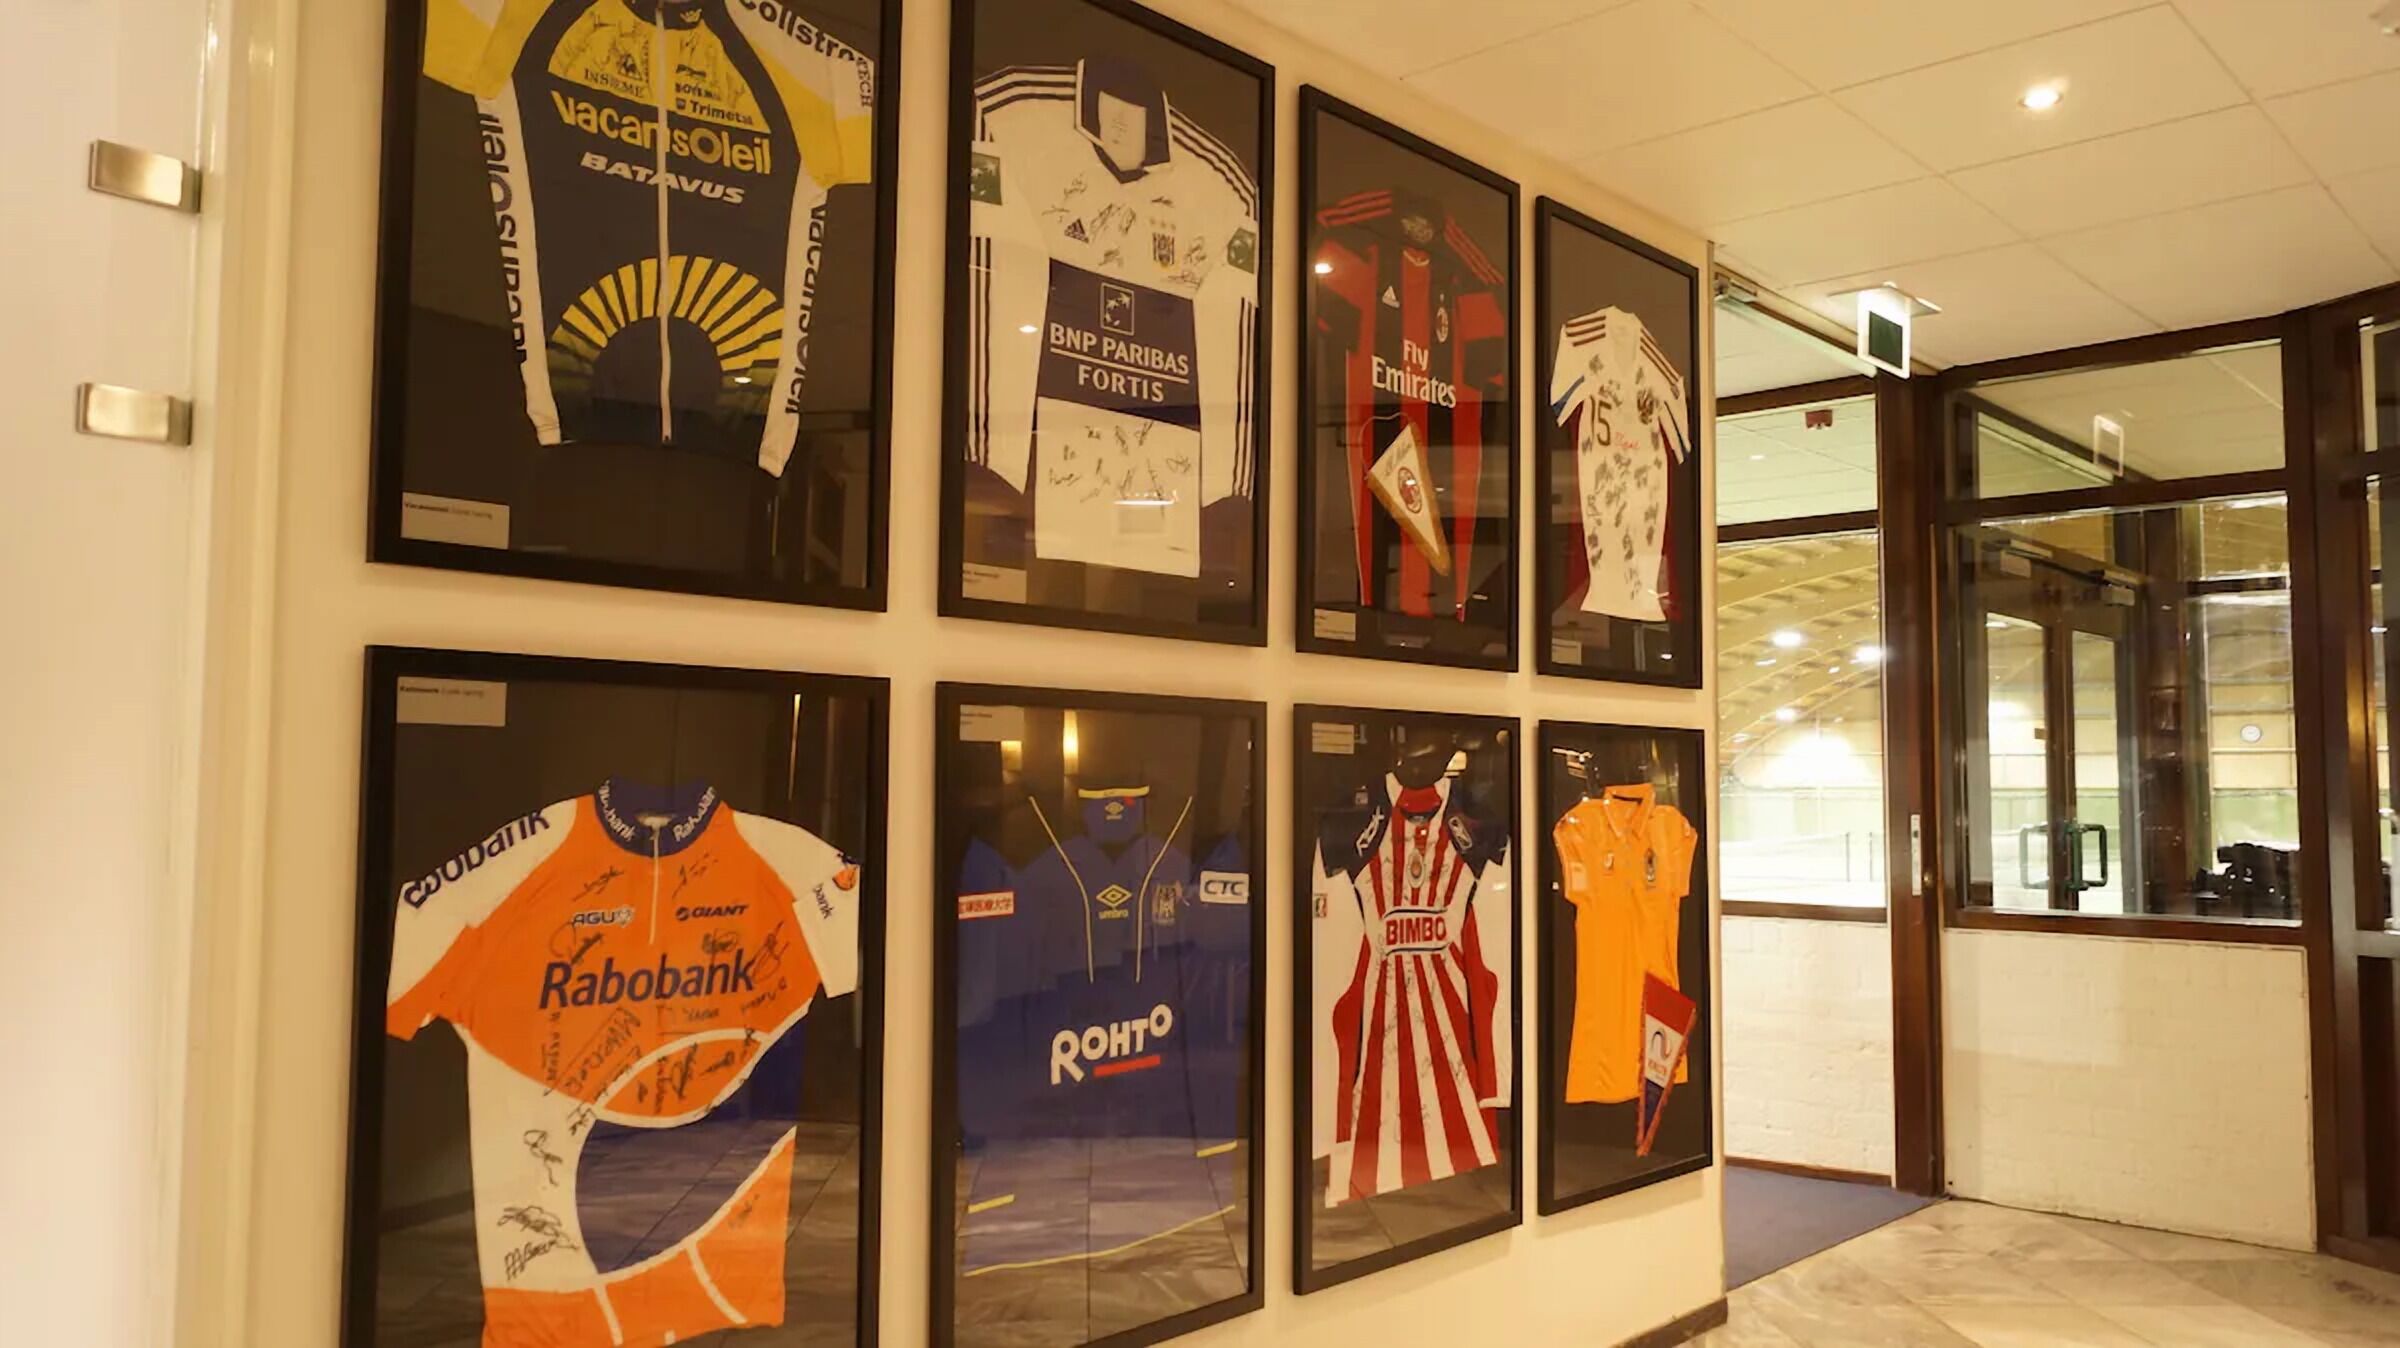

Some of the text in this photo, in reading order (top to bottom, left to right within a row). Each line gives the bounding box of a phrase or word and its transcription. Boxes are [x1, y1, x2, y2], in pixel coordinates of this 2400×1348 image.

[580, 151, 745, 205] BATAVUS
[1050, 322, 1189, 376] BNP PARIBAS
[1403, 338, 1429, 371] Fly
[1078, 364, 1165, 403] FORTIS
[1372, 354, 1457, 409] Emirates
[1204, 879, 1245, 896] CTC
[572, 909, 617, 927] AGU
[691, 905, 749, 919] GIANT
[1385, 916, 1448, 946] BIMBO
[538, 947, 755, 1010] Rabobank
[1050, 1003, 1174, 1085] ROHTO
